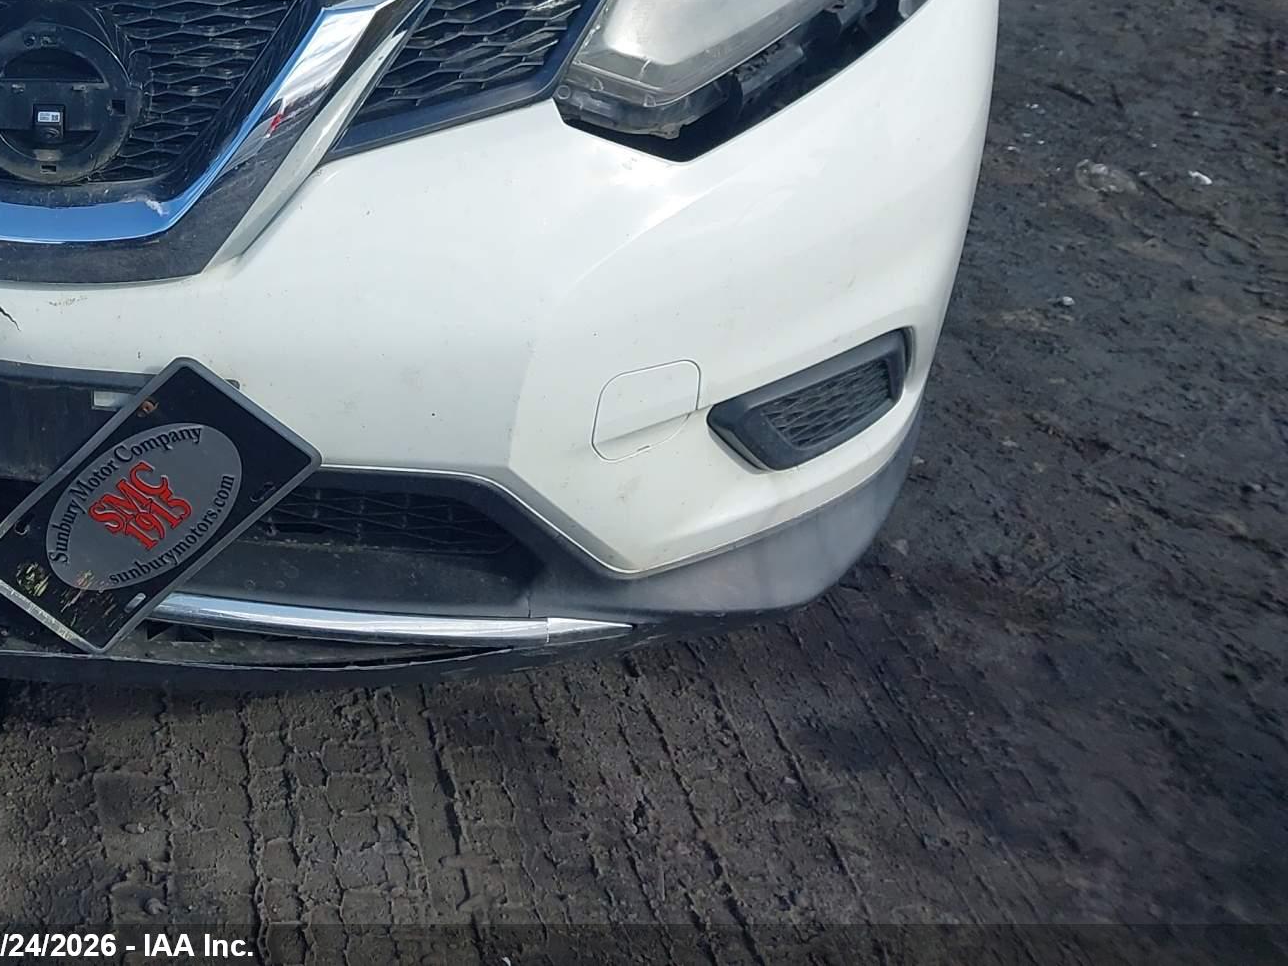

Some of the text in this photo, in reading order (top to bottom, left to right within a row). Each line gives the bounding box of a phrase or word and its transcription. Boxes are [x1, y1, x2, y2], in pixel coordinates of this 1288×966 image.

[49, 425, 203, 564] Sunbury Motor Company
[88, 460, 169, 534] SMC
[109, 474, 235, 584] sunburymotors.com
[124, 489, 193, 551] 1915
